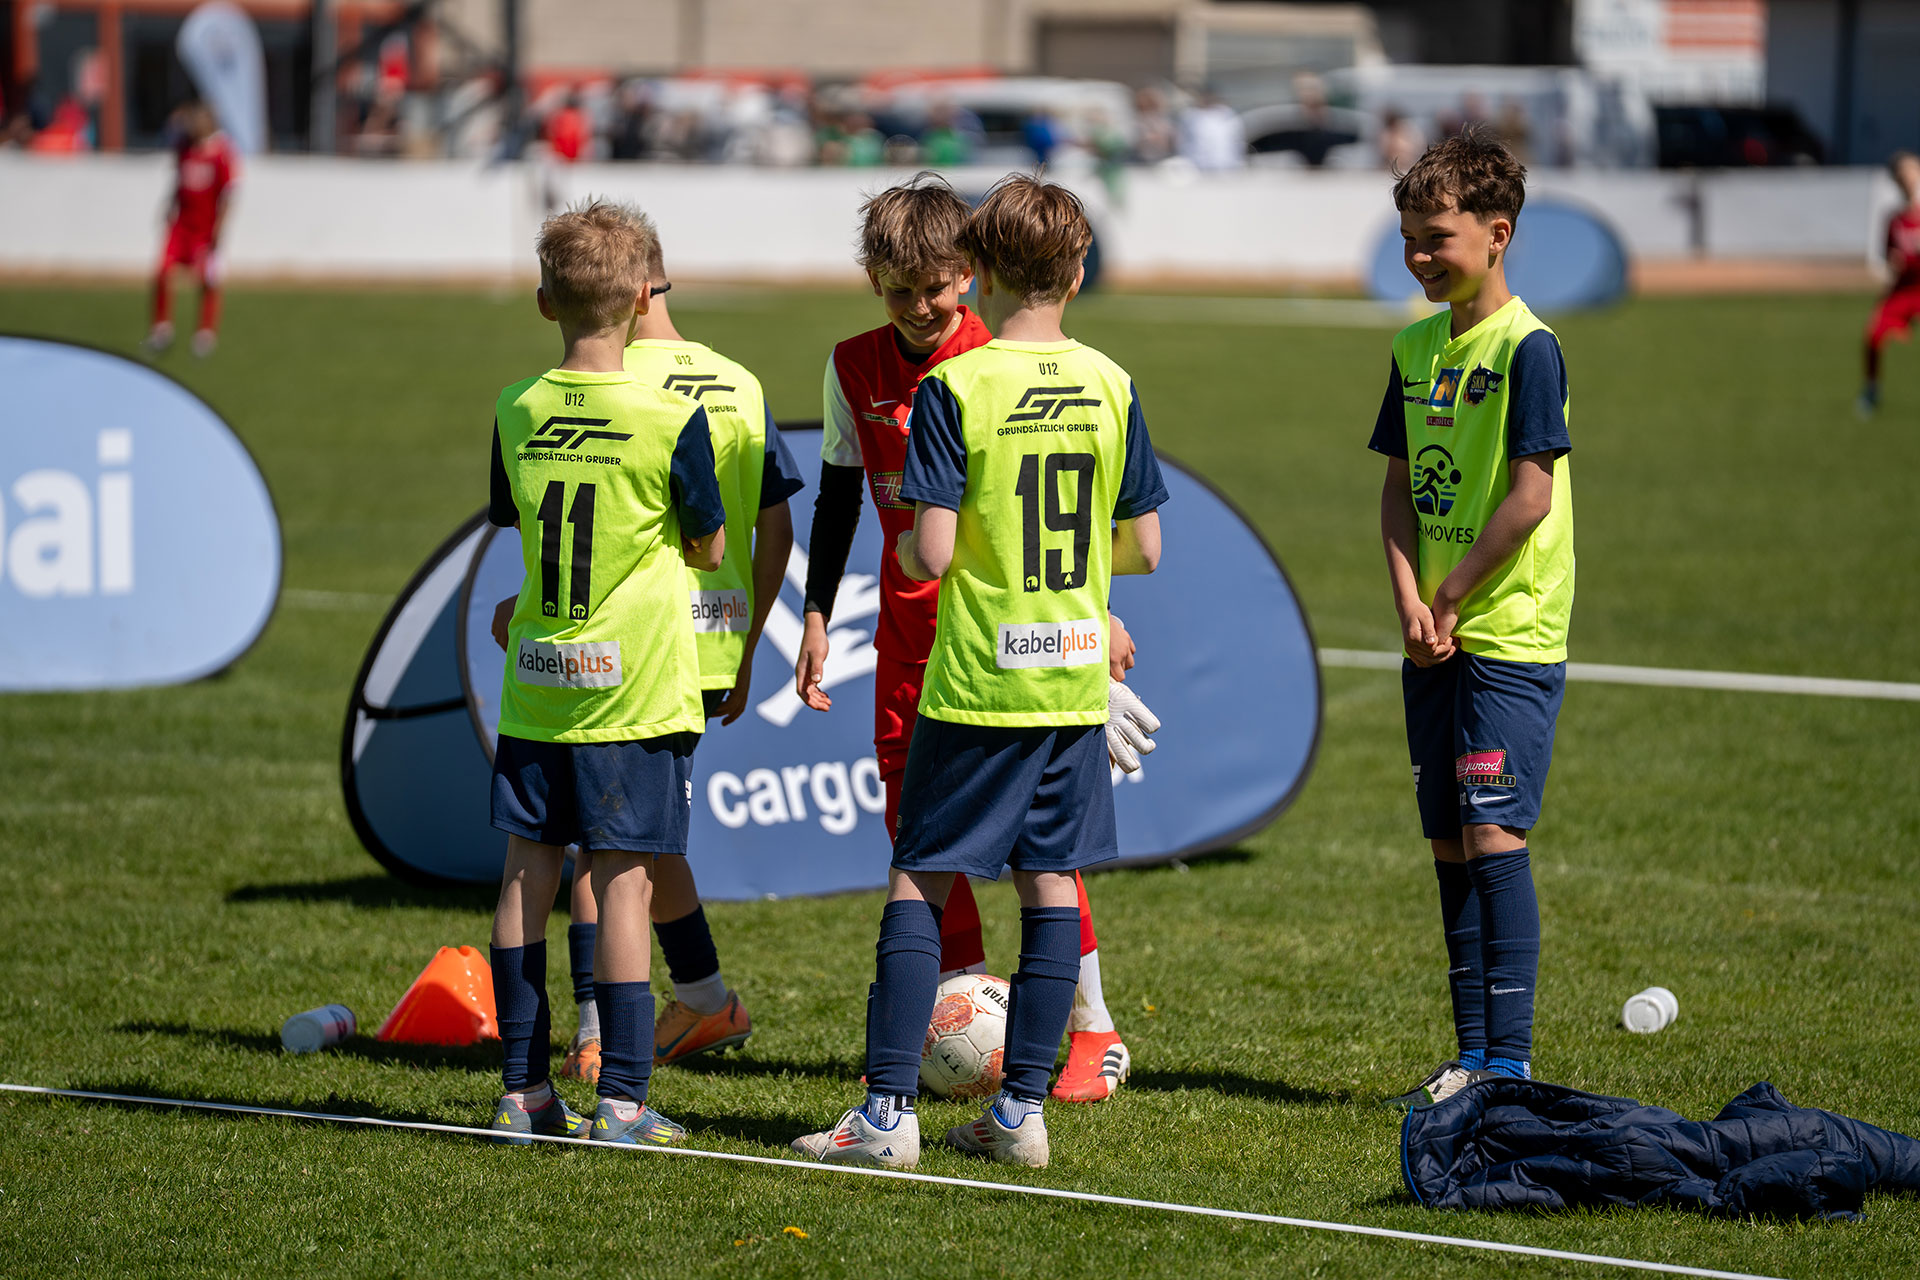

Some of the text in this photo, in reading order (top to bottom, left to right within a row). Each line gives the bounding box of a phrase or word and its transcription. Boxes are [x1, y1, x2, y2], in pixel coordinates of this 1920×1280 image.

[674, 354, 694, 366] U12
[1039, 362, 1059, 376] U12
[565, 392, 585, 407] U12
[707, 405, 738, 414] GRUBER
[996, 422, 1099, 437] GRUNDSÄTZLICH GRUBER
[517, 450, 622, 467] GRUNDSÄTZLICH GRUBER
[0, 427, 133, 600] ai
[1015, 453, 1096, 592] 19
[1424, 522, 1475, 544] MOVES
[537, 480, 596, 620] 11
[691, 596, 748, 625] abelplus
[1003, 629, 1097, 660] kabelplus
[518, 645, 613, 680] kabelplus
